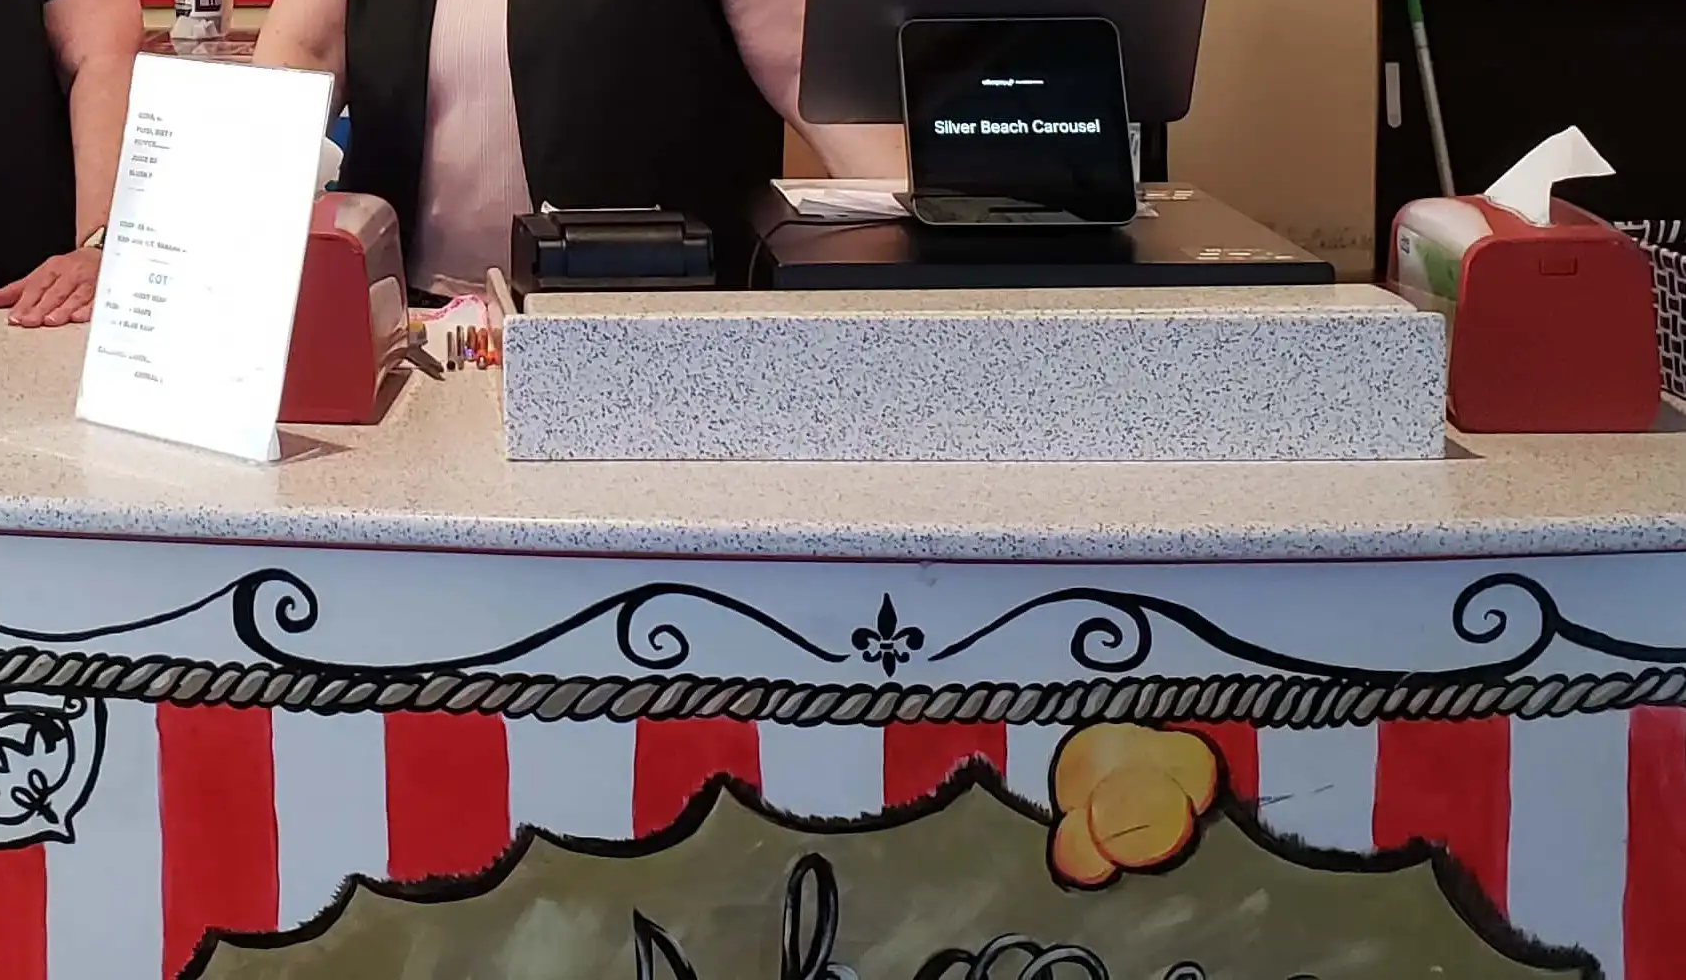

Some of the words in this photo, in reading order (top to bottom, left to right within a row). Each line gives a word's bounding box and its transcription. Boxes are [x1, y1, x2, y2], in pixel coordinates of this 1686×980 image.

[934, 120, 977, 135] Silver
[980, 120, 1029, 135] Beach
[1032, 118, 1101, 134] Carousel
